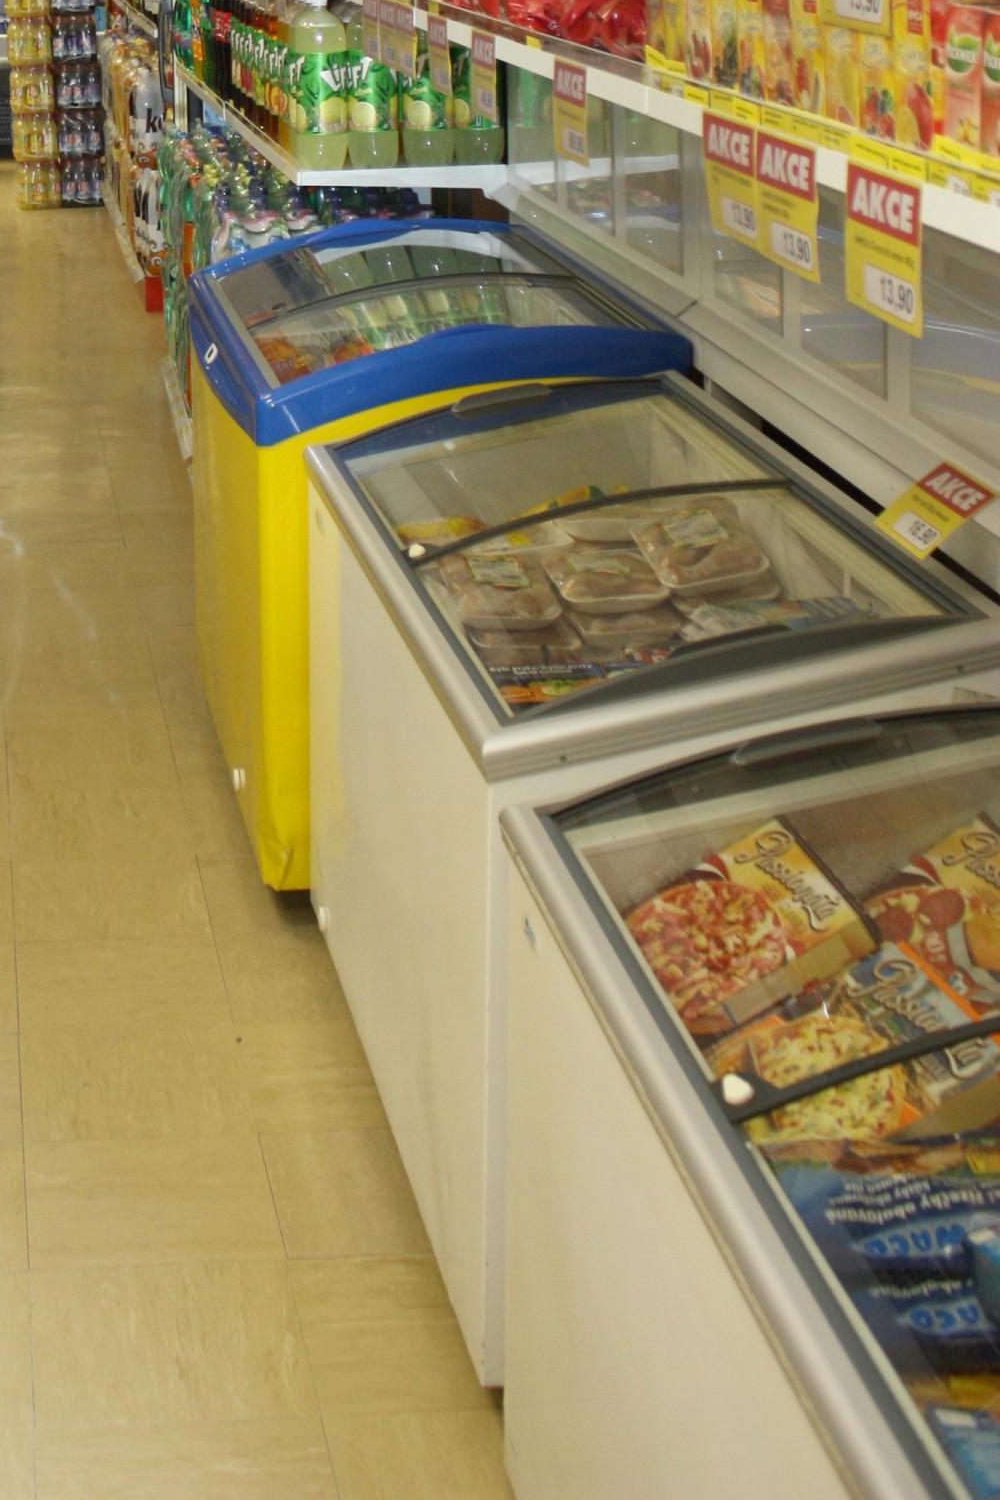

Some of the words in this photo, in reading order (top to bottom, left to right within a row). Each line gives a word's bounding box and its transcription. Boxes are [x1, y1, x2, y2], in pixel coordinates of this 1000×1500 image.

[430, 24, 447, 46] AKCE
[474, 38, 494, 64] AKCE
[557, 69, 584, 100] AKCE
[708, 123, 750, 167] AKCE
[760, 143, 811, 192] AKCE
[732, 203, 755, 231] 13,90
[853, 177, 914, 234] AKCE
[784, 231, 811, 263] 13,90
[880, 275, 914, 314] 13,90
[925, 471, 987, 512] AKCE
[863, 1223, 965, 1257] WACO
